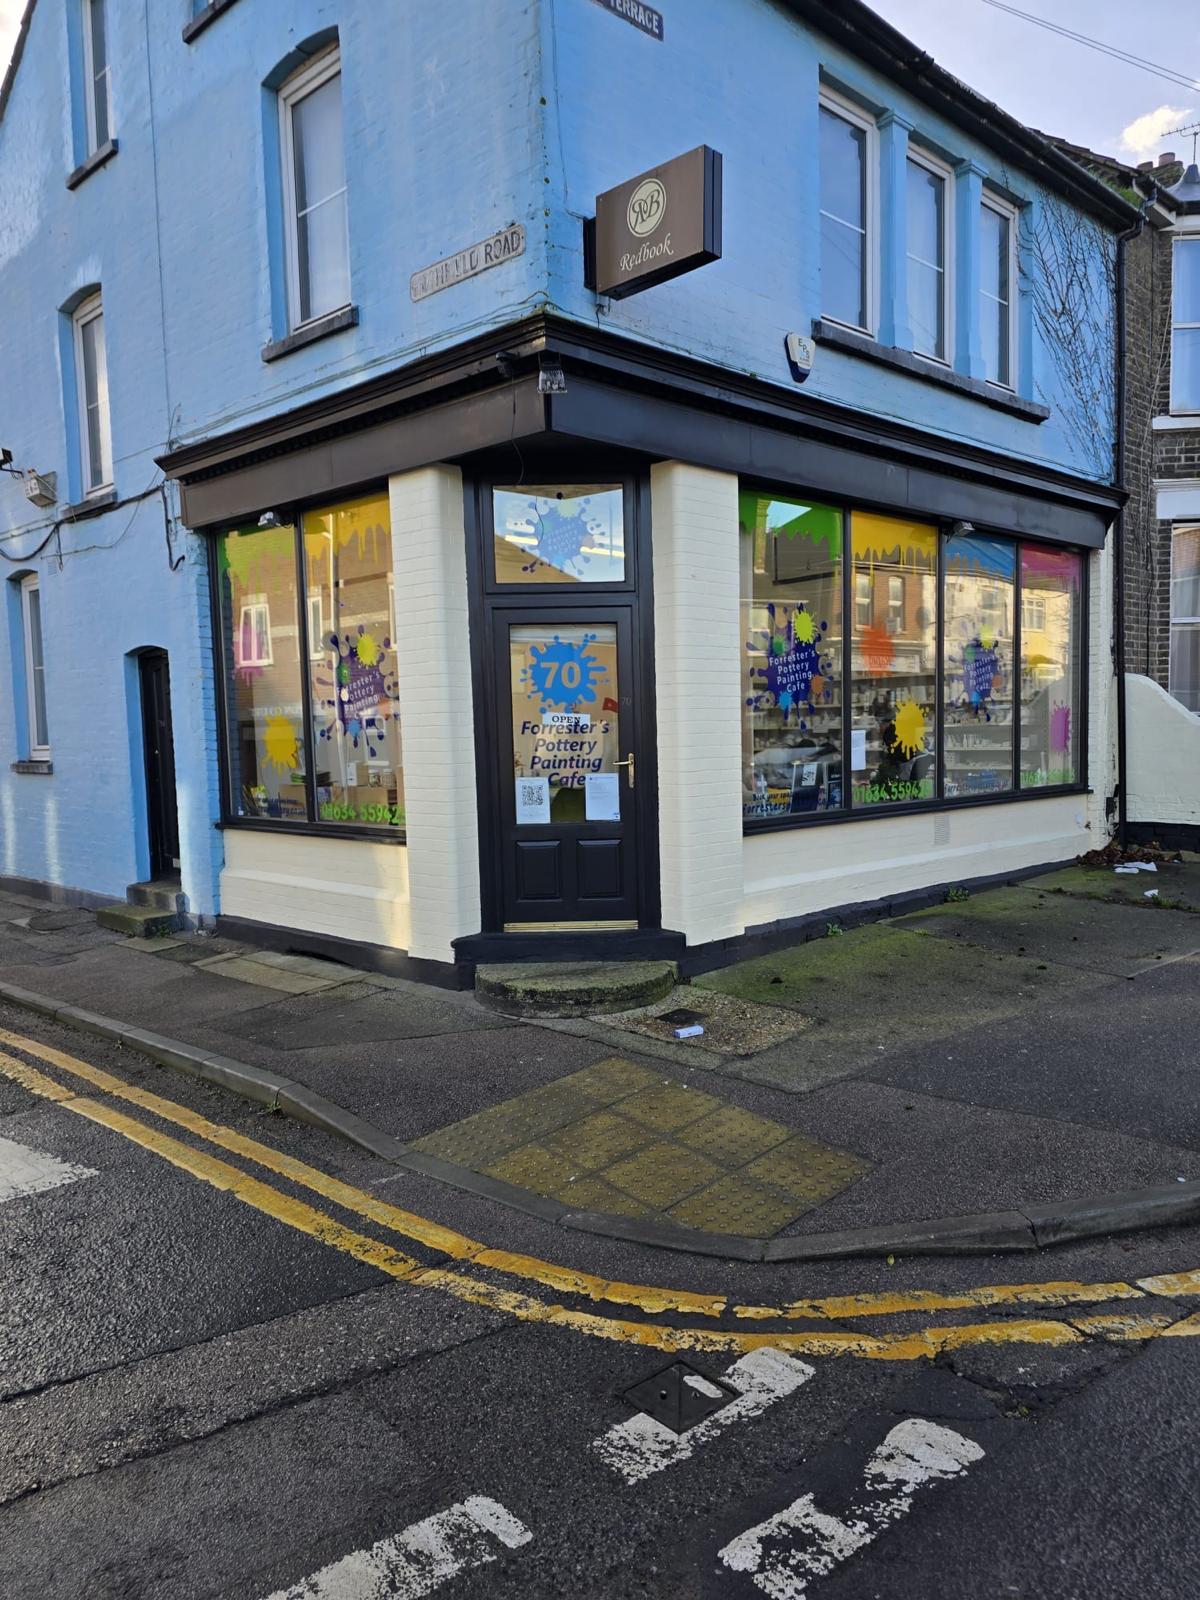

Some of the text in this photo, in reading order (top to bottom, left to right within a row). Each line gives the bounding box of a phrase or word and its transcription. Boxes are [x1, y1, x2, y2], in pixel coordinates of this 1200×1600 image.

[485, 231, 520, 264] ROAD
[620, 233, 674, 271] Redbook
[769, 648, 816, 666] Forrester's
[541, 662, 581, 689] 70
[777, 662, 809, 675] Pottery
[777, 671, 812, 685] Painting
[345, 685, 375, 702] ottery
[787, 683, 805, 693] Cafe
[521, 719, 610, 735] Forrester's
[551, 714, 582, 725] OPEN
[534, 738, 598, 755] Pottery
[530, 755, 603, 772] Painting
[548, 772, 586, 789] Cafe
